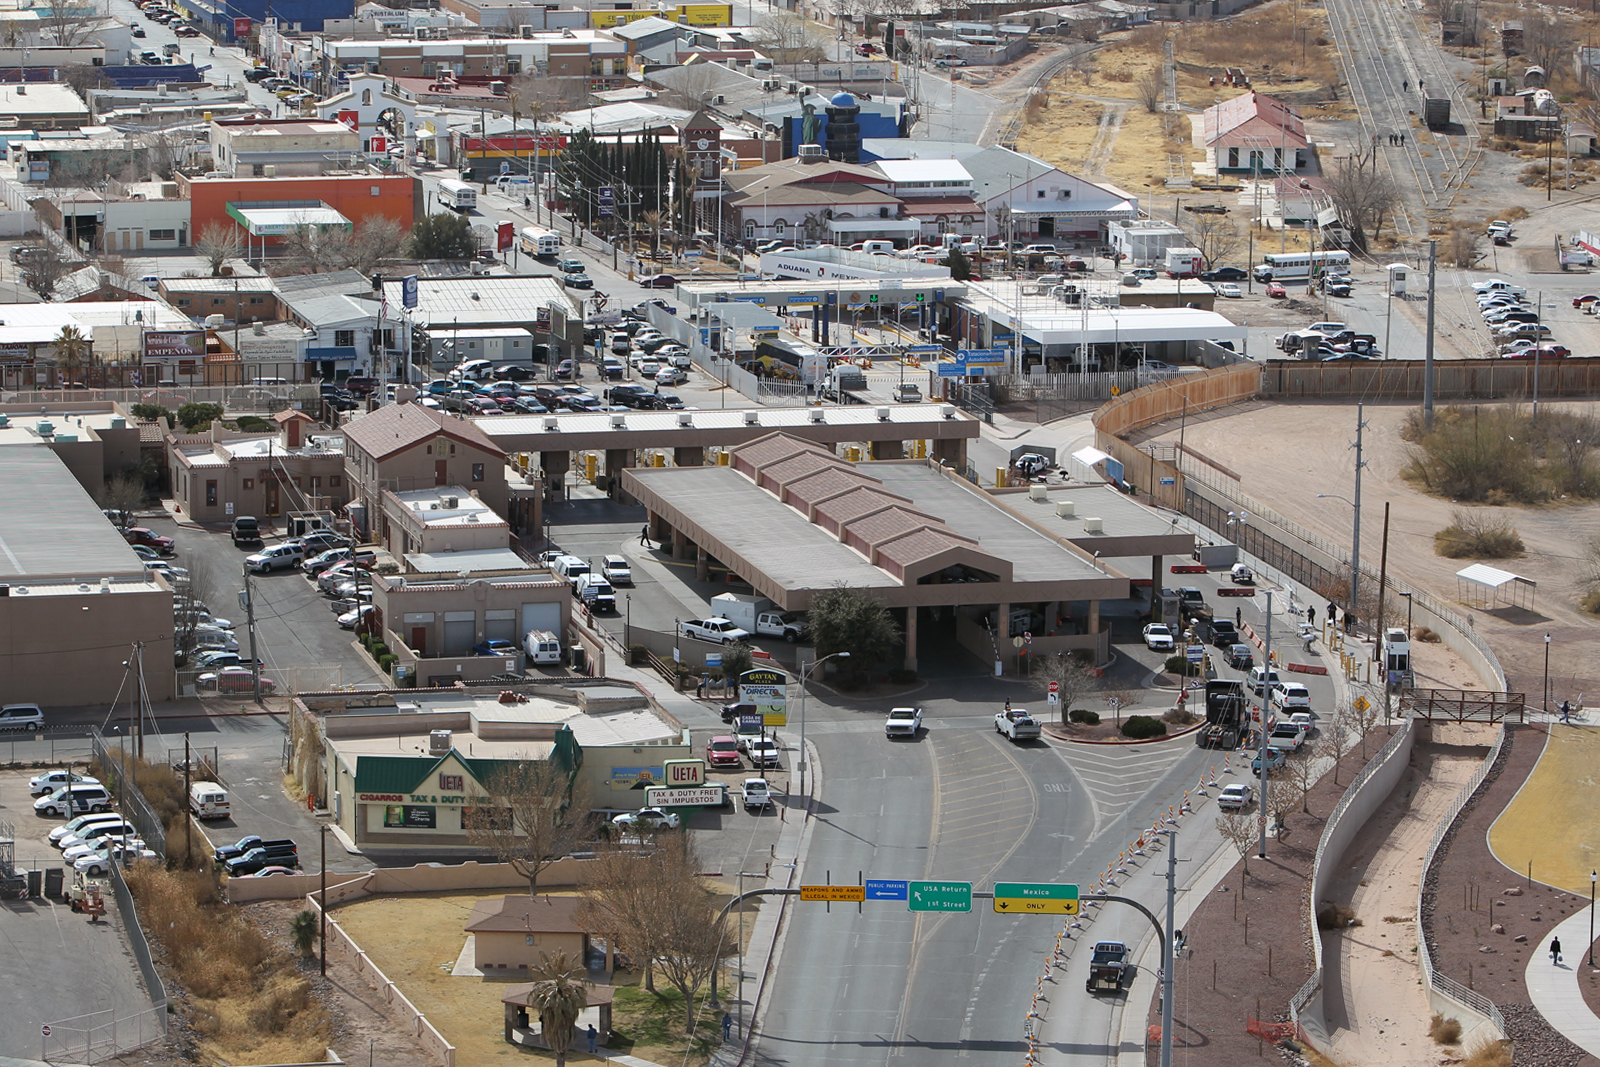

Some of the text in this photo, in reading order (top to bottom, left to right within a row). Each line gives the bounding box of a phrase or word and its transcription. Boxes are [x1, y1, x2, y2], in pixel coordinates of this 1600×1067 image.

[777, 263, 811, 274] ADUANA
[148, 346, 193, 355] EMPEÑOS
[749, 673, 777, 681] GAYTAN
[673, 766, 698, 782] UETA
[438, 771, 464, 792] UETA
[1043, 783, 1072, 793] ONLY
[360, 794, 403, 802] CIGARROS
[410, 794, 428, 803] TAX
[430, 795, 437, 803] &
[441, 795, 465, 803] DUTY
[672, 796, 714, 804] IMPUESTOS
